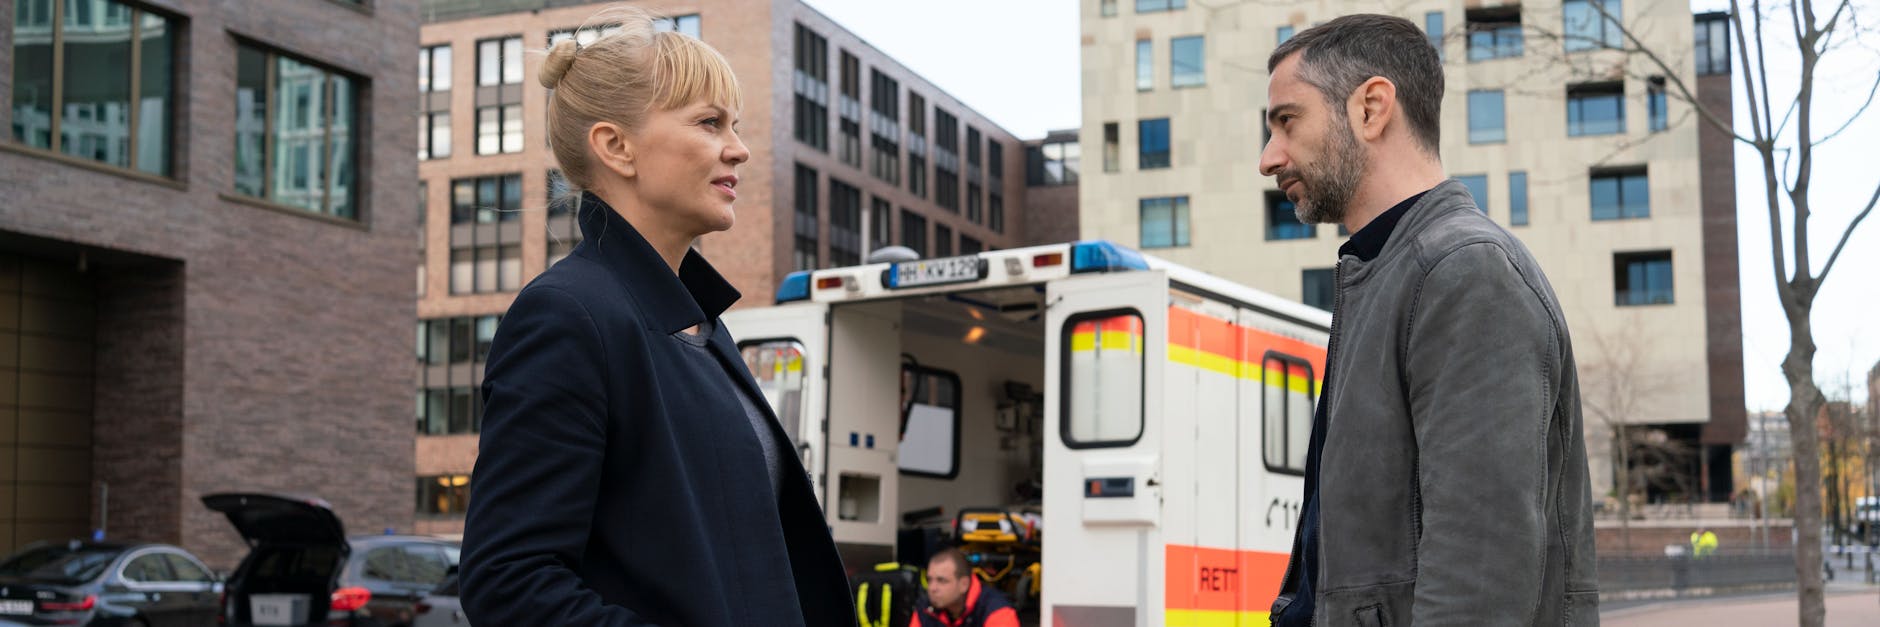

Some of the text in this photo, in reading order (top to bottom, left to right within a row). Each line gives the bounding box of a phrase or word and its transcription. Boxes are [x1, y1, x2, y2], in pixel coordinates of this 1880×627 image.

[899, 256, 977, 283] HH KW 129
